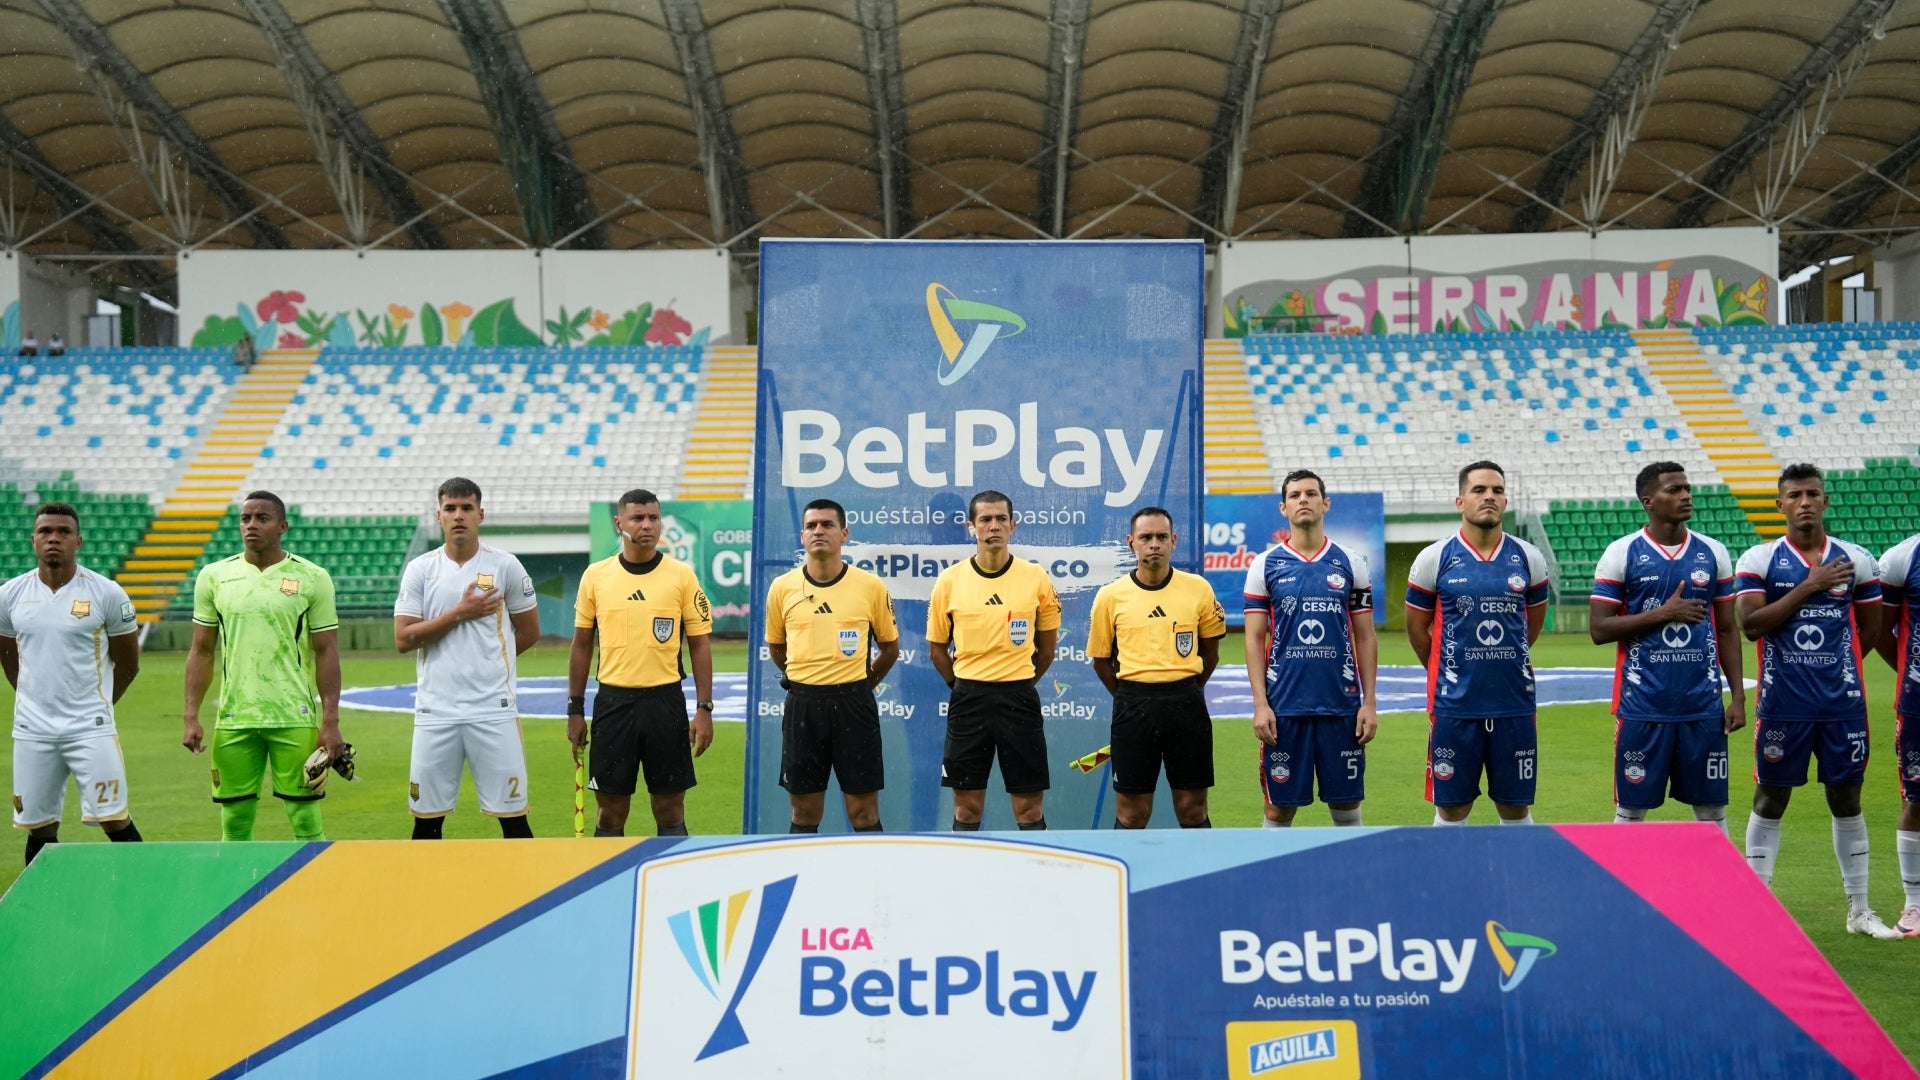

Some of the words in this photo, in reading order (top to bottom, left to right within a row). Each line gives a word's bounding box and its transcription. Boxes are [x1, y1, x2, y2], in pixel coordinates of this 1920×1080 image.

[781, 401, 1164, 507] BetPlay
[845, 506, 945, 528] puéstale
[953, 510, 966, 525] a
[1302, 602, 1342, 614] CESAR
[1480, 602, 1517, 614] CESAR
[1800, 608, 1842, 618] CESAR
[840, 631, 857, 639] FIFA
[1011, 620, 1027, 628] FIFA
[1286, 651, 1305, 659] SAN
[1306, 650, 1337, 659] MATEO
[1464, 652, 1484, 661] SAN
[1486, 651, 1517, 660] MATEO
[1649, 654, 1669, 663] SAN
[1672, 653, 1704, 662] MATEO
[1782, 655, 1802, 664] SAN
[1804, 656, 1838, 665] MATEO
[1341, 749, 1362, 758] PIN-GO
[1851, 739, 1866, 762] 21
[1347, 758, 1358, 780] 5
[1518, 758, 1534, 780] 18
[1706, 757, 1728, 780] 60
[95, 779, 120, 804] 27
[508, 776, 521, 798] 2
[801, 927, 873, 951] LIGA
[1219, 922, 1478, 994] BetPlay
[799, 950, 1097, 1032] BetPlay
[1253, 993, 1336, 1009] Apuéstale
[1339, 996, 1350, 1006] a
[1353, 993, 1371, 1006] tu
[1375, 991, 1430, 1008] pasión
[1255, 1032, 1331, 1071] AGUILA
